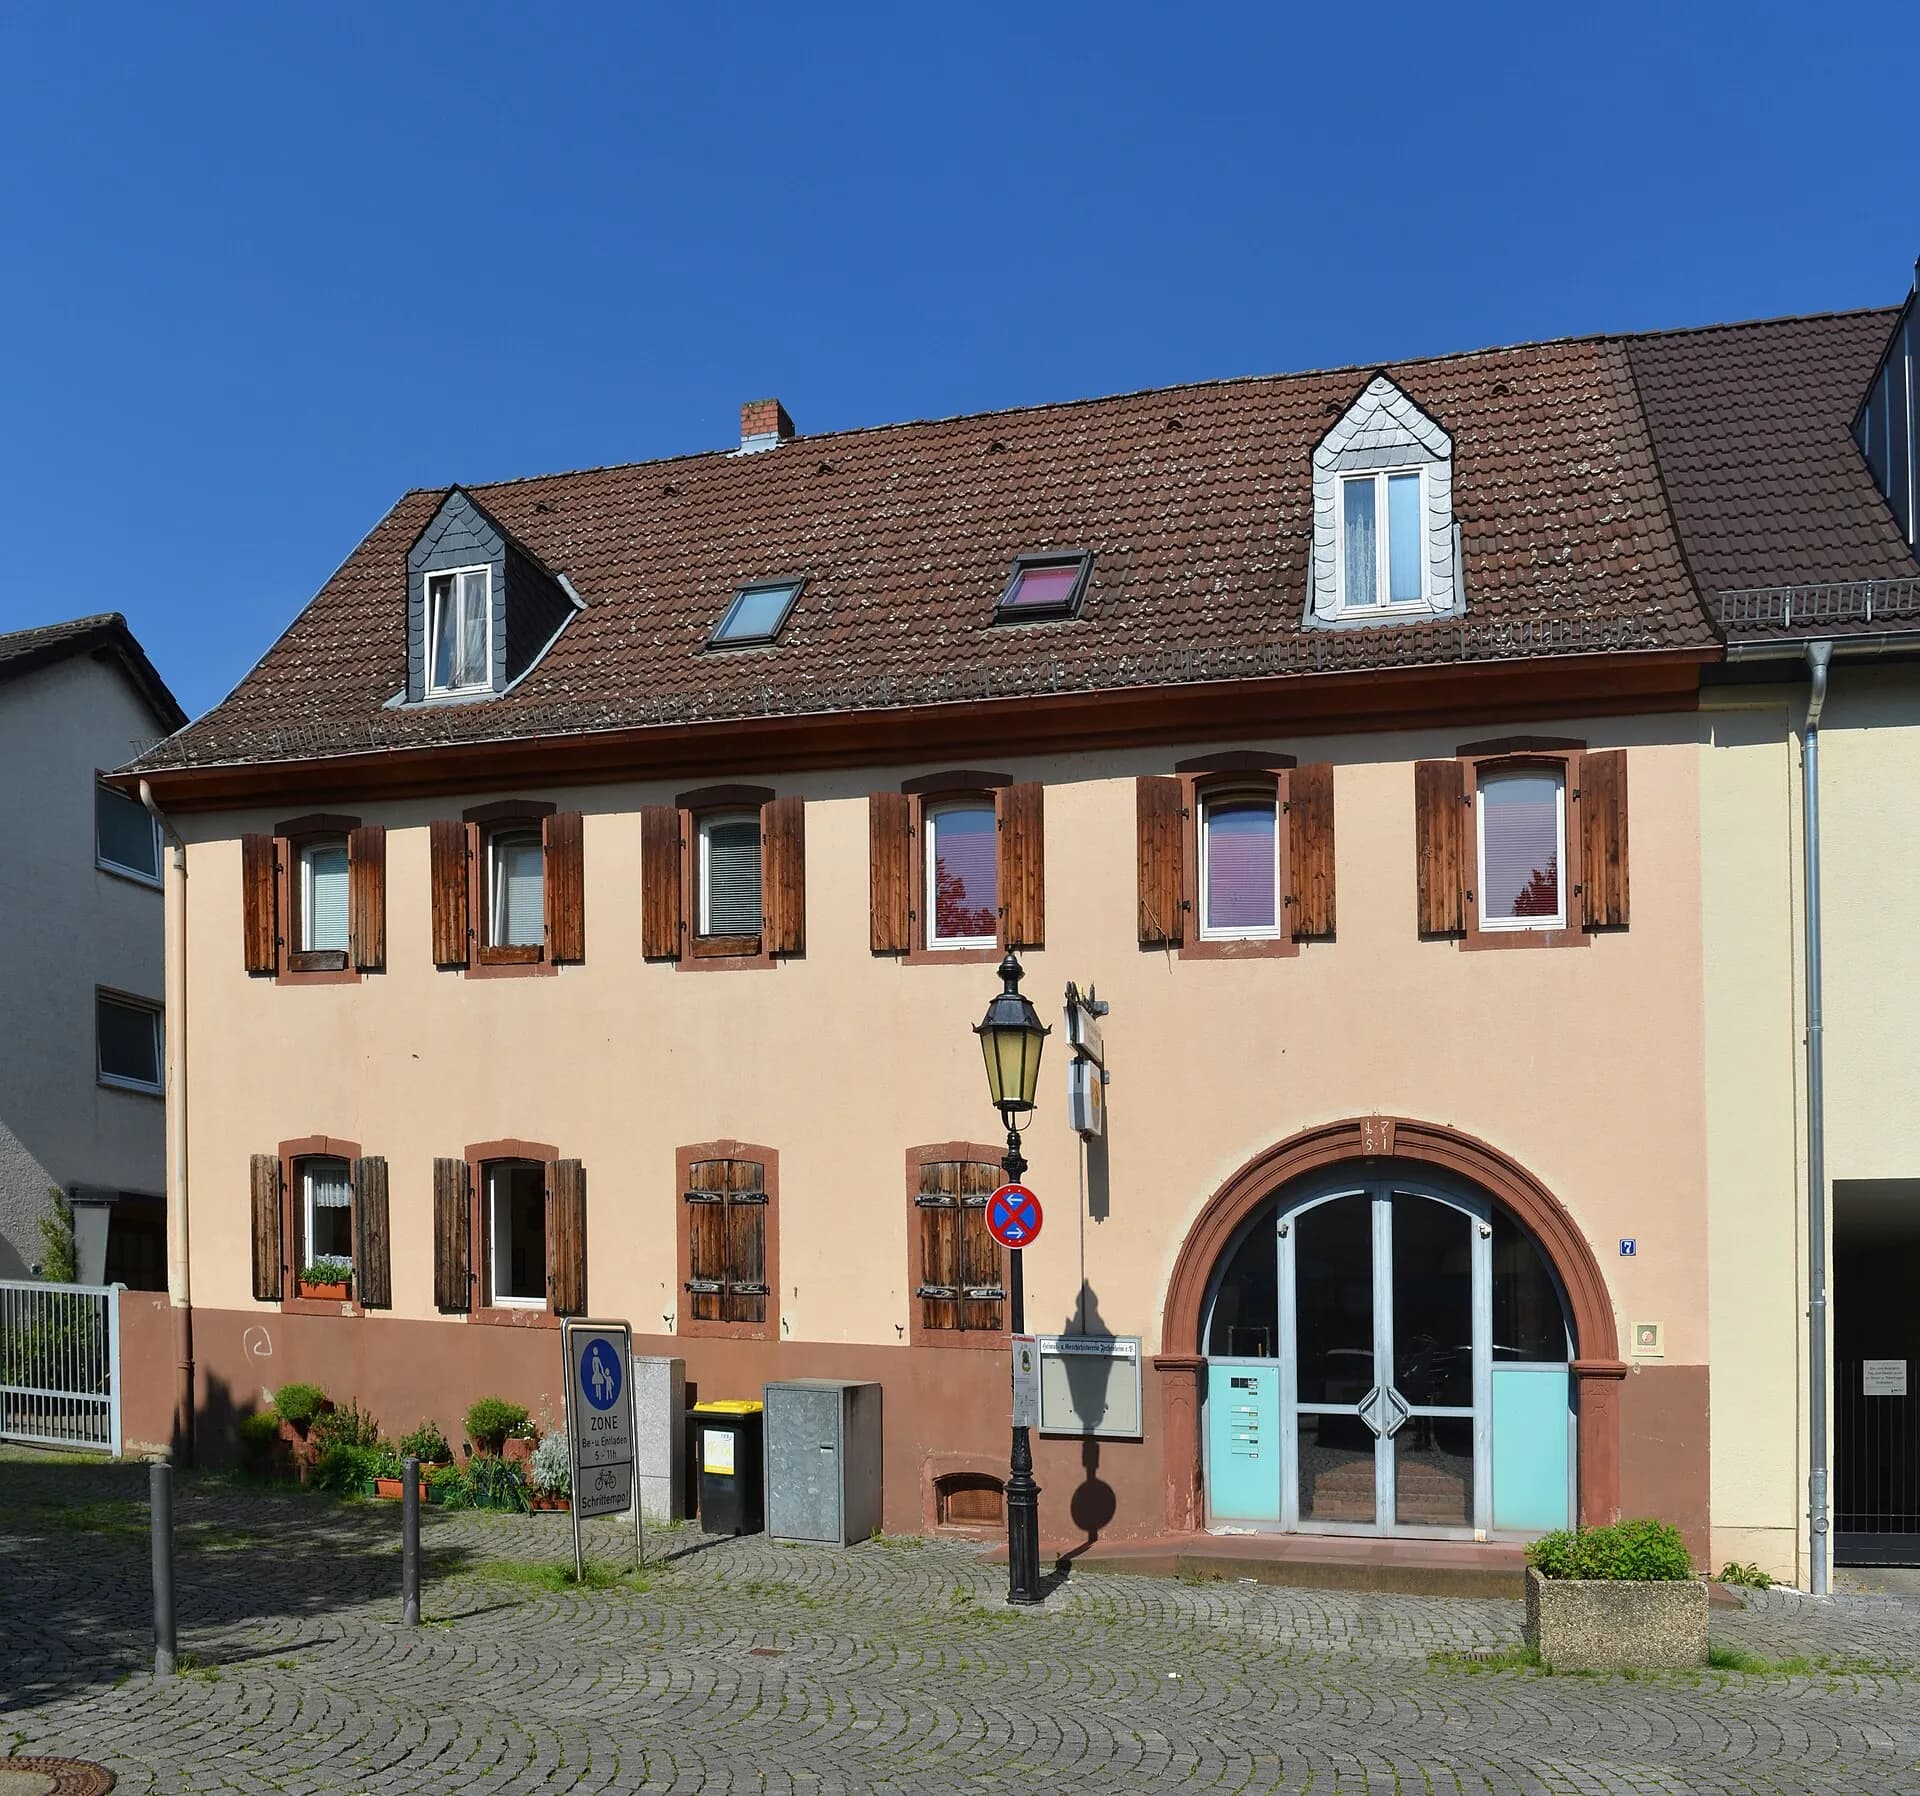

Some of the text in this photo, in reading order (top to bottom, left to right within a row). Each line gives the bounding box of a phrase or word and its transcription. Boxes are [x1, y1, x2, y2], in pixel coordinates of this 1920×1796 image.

[1624, 1241, 1632, 1254] 7
[590, 1415, 619, 1431] ZONE
[601, 1435, 628, 1447] Entladen
